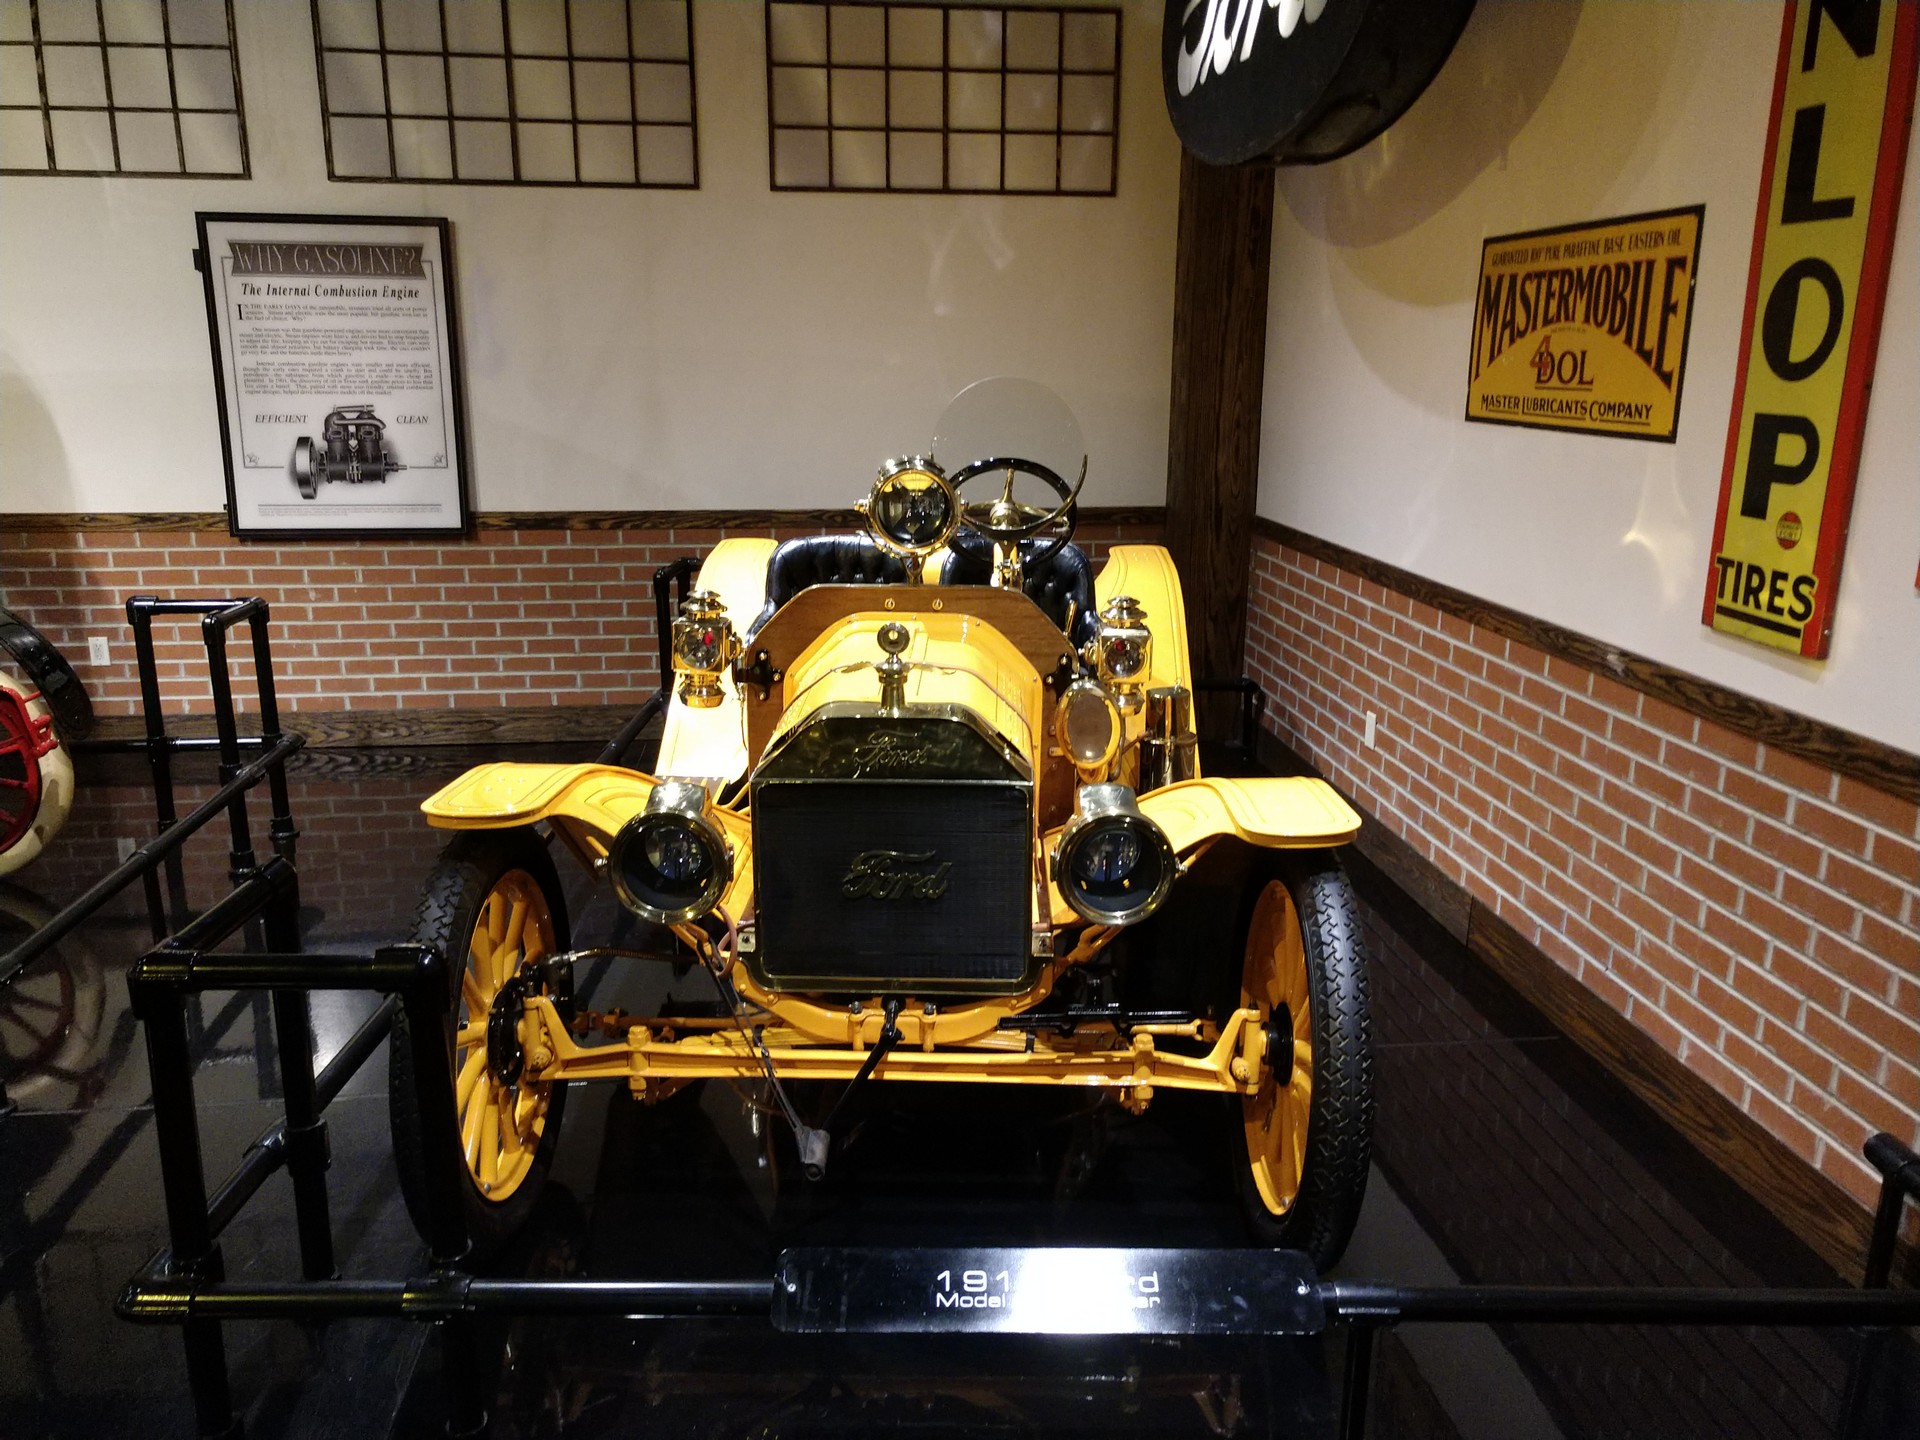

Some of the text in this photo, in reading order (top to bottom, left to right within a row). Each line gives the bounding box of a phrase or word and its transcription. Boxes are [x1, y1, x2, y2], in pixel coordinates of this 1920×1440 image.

[1603, 235, 1625, 255] BASE
[1628, 229, 1665, 252] EASTERN
[1667, 227, 1682, 247] OIL
[235, 244, 416, 275] WHY GASOLINE?
[241, 283, 420, 302] The Internal Combustion Engine
[1473, 255, 1688, 394] MASTERMOBILE
[255, 414, 309, 424] EFFICIENT
[396, 415, 429, 424] CLEAN
[1481, 394, 1653, 422] MASTER LUBRICANTS COMPANY
[1716, 557, 1816, 623] TIRES
[852, 729, 932, 770] Ford
[841, 850, 952, 899] Ford
[937, 1270, 1010, 1292] 191
[936, 1293, 1006, 1308] Model
